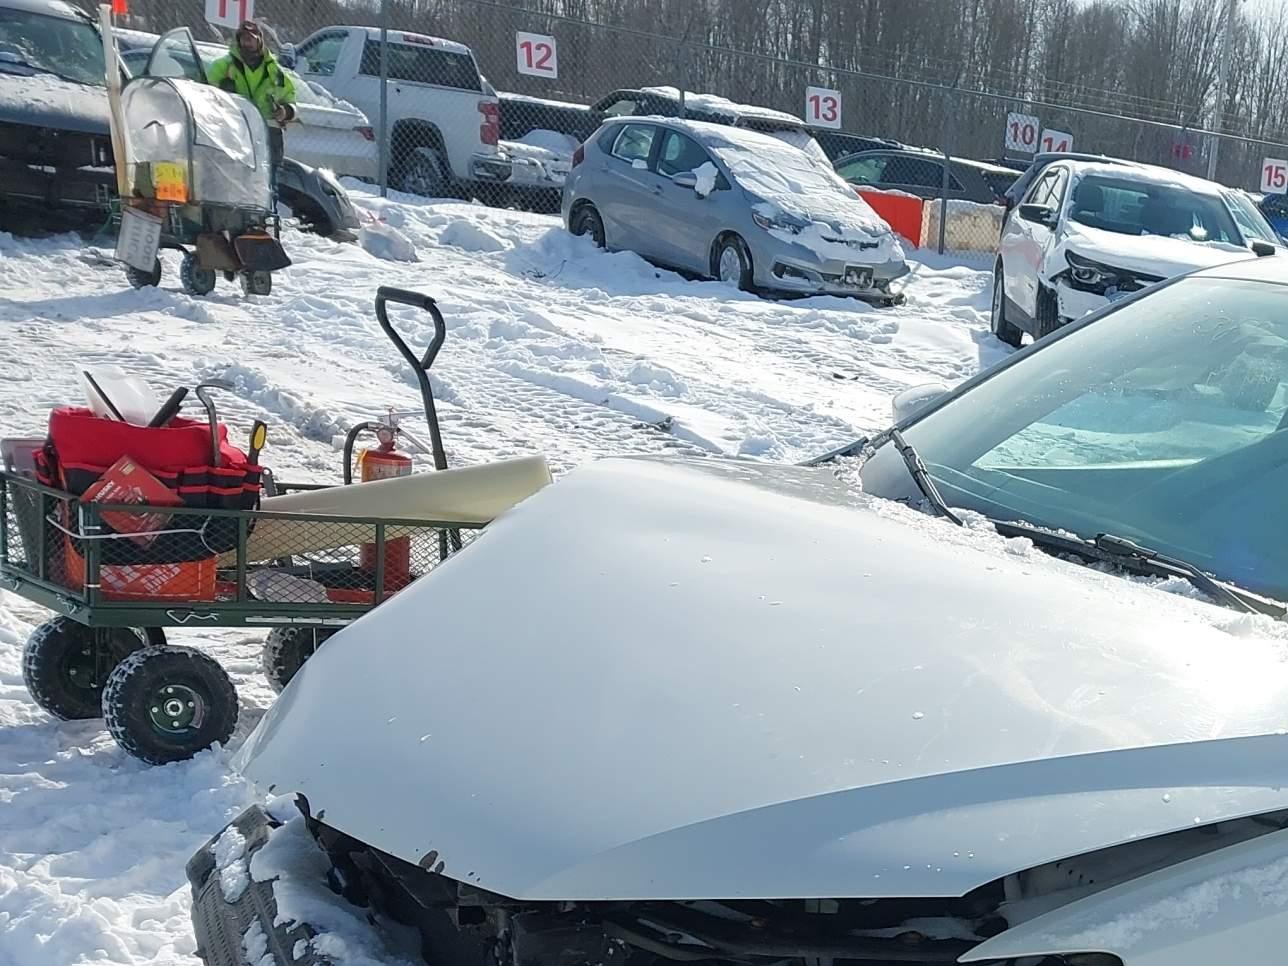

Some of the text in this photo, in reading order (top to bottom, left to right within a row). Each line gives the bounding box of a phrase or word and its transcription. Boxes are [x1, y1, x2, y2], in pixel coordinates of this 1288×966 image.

[520, 41, 554, 71] 12
[809, 95, 838, 122] 13
[1009, 121, 1035, 146] 10
[1264, 164, 1286, 188] 15
